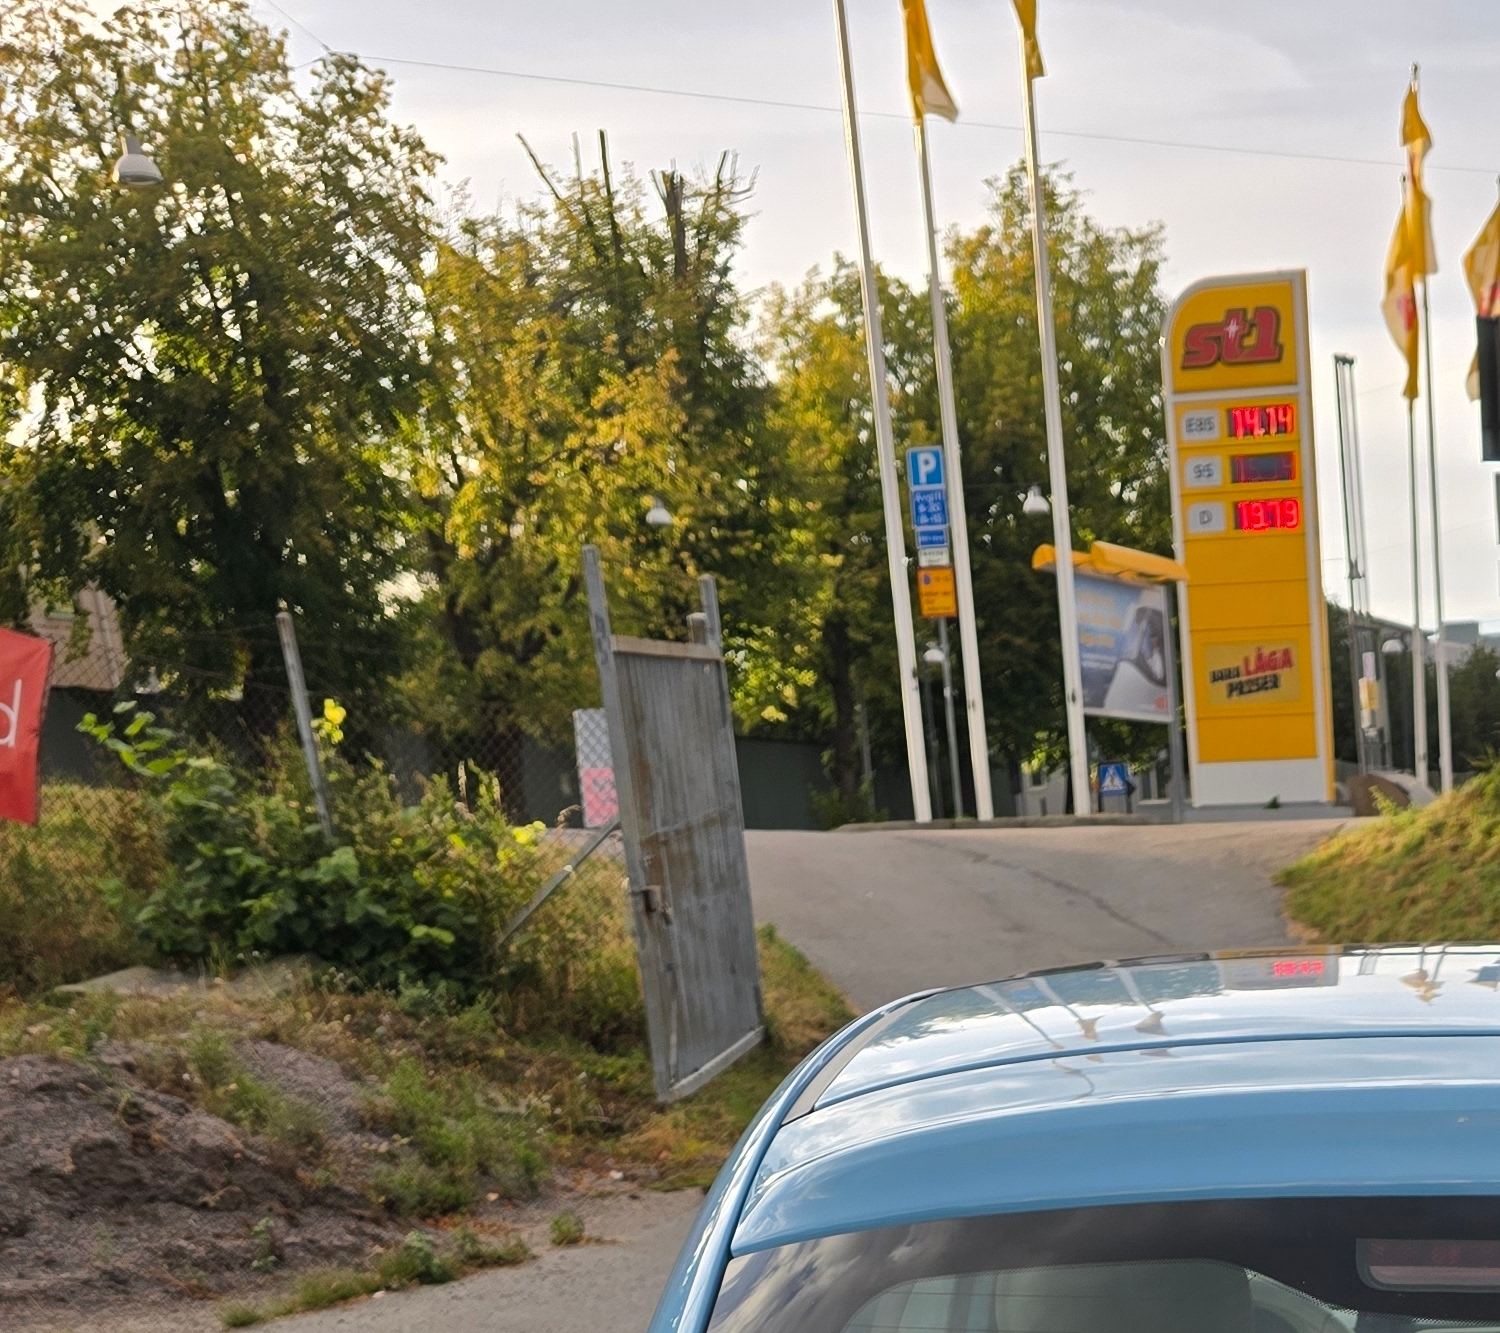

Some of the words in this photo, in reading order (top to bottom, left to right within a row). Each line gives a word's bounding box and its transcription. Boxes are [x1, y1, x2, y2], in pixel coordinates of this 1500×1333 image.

[1185, 416, 1216, 433] E85
[1232, 404, 1294, 439] 14.14
[917, 452, 937, 485] P
[1193, 463, 1215, 479] 95
[1198, 509, 1213, 525] D
[1243, 646, 1293, 676] LÅGA
